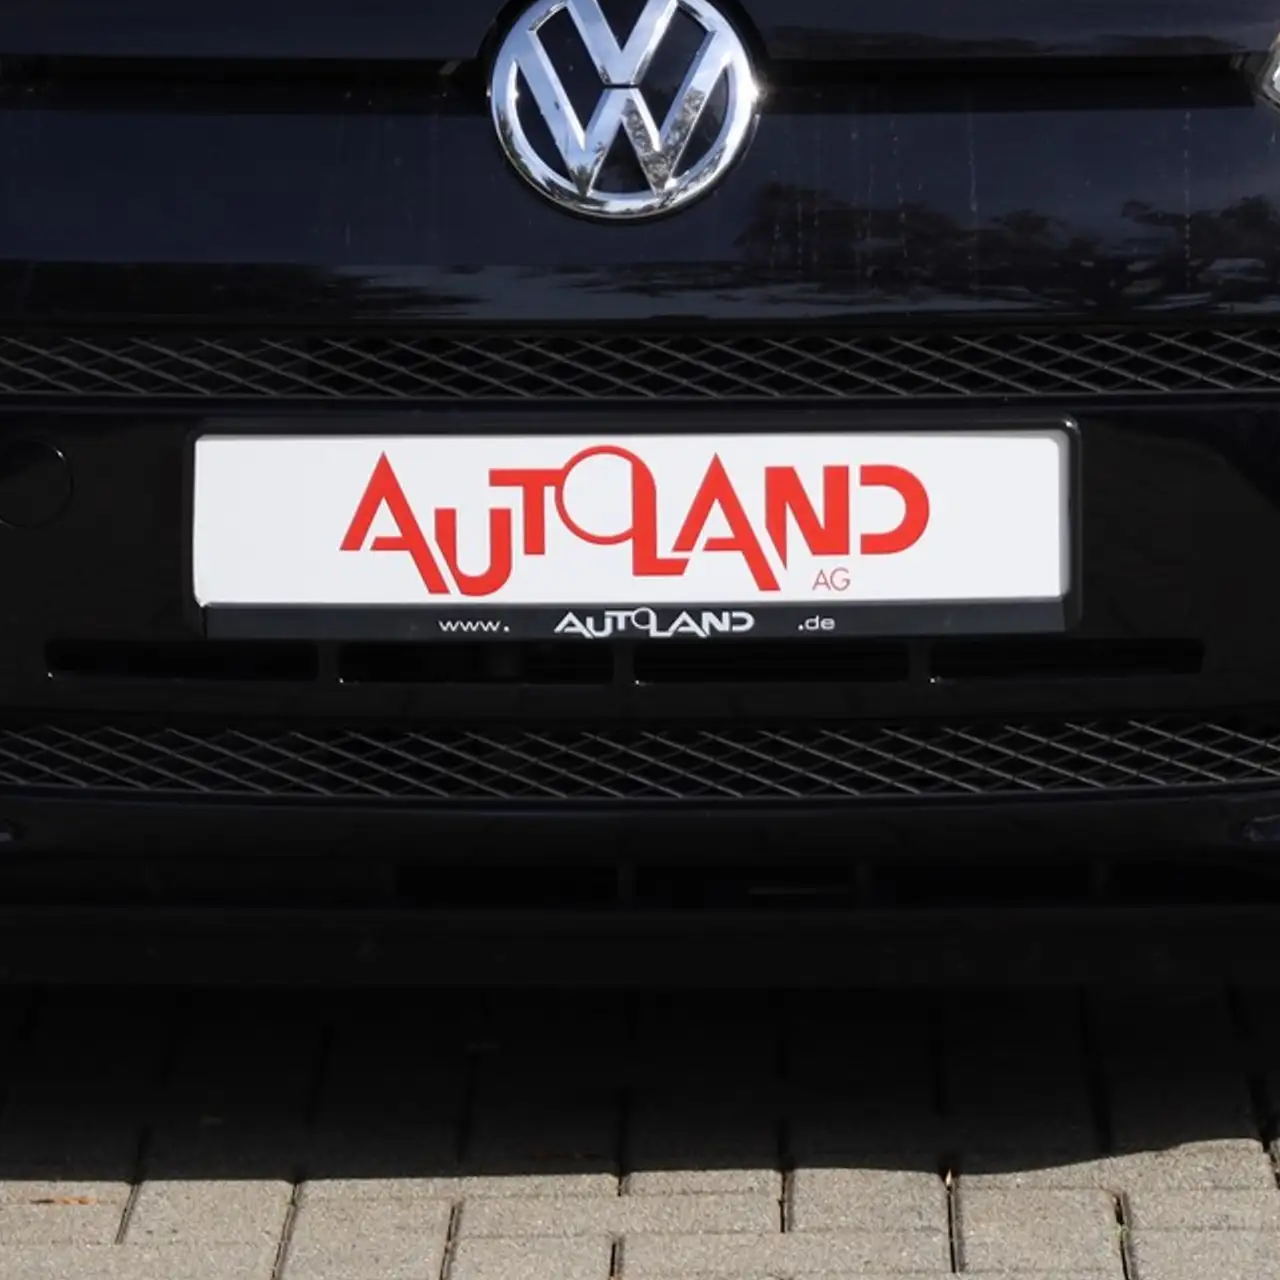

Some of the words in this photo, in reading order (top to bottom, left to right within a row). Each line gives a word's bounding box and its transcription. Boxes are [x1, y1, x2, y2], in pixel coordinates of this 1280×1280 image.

[339, 444, 931, 597] AUTOLAND
[811, 566, 852, 592] AG
[437, 620, 511, 633] www.
[553, 606, 756, 639] AUTOLAND
[797, 615, 836, 632] .de
